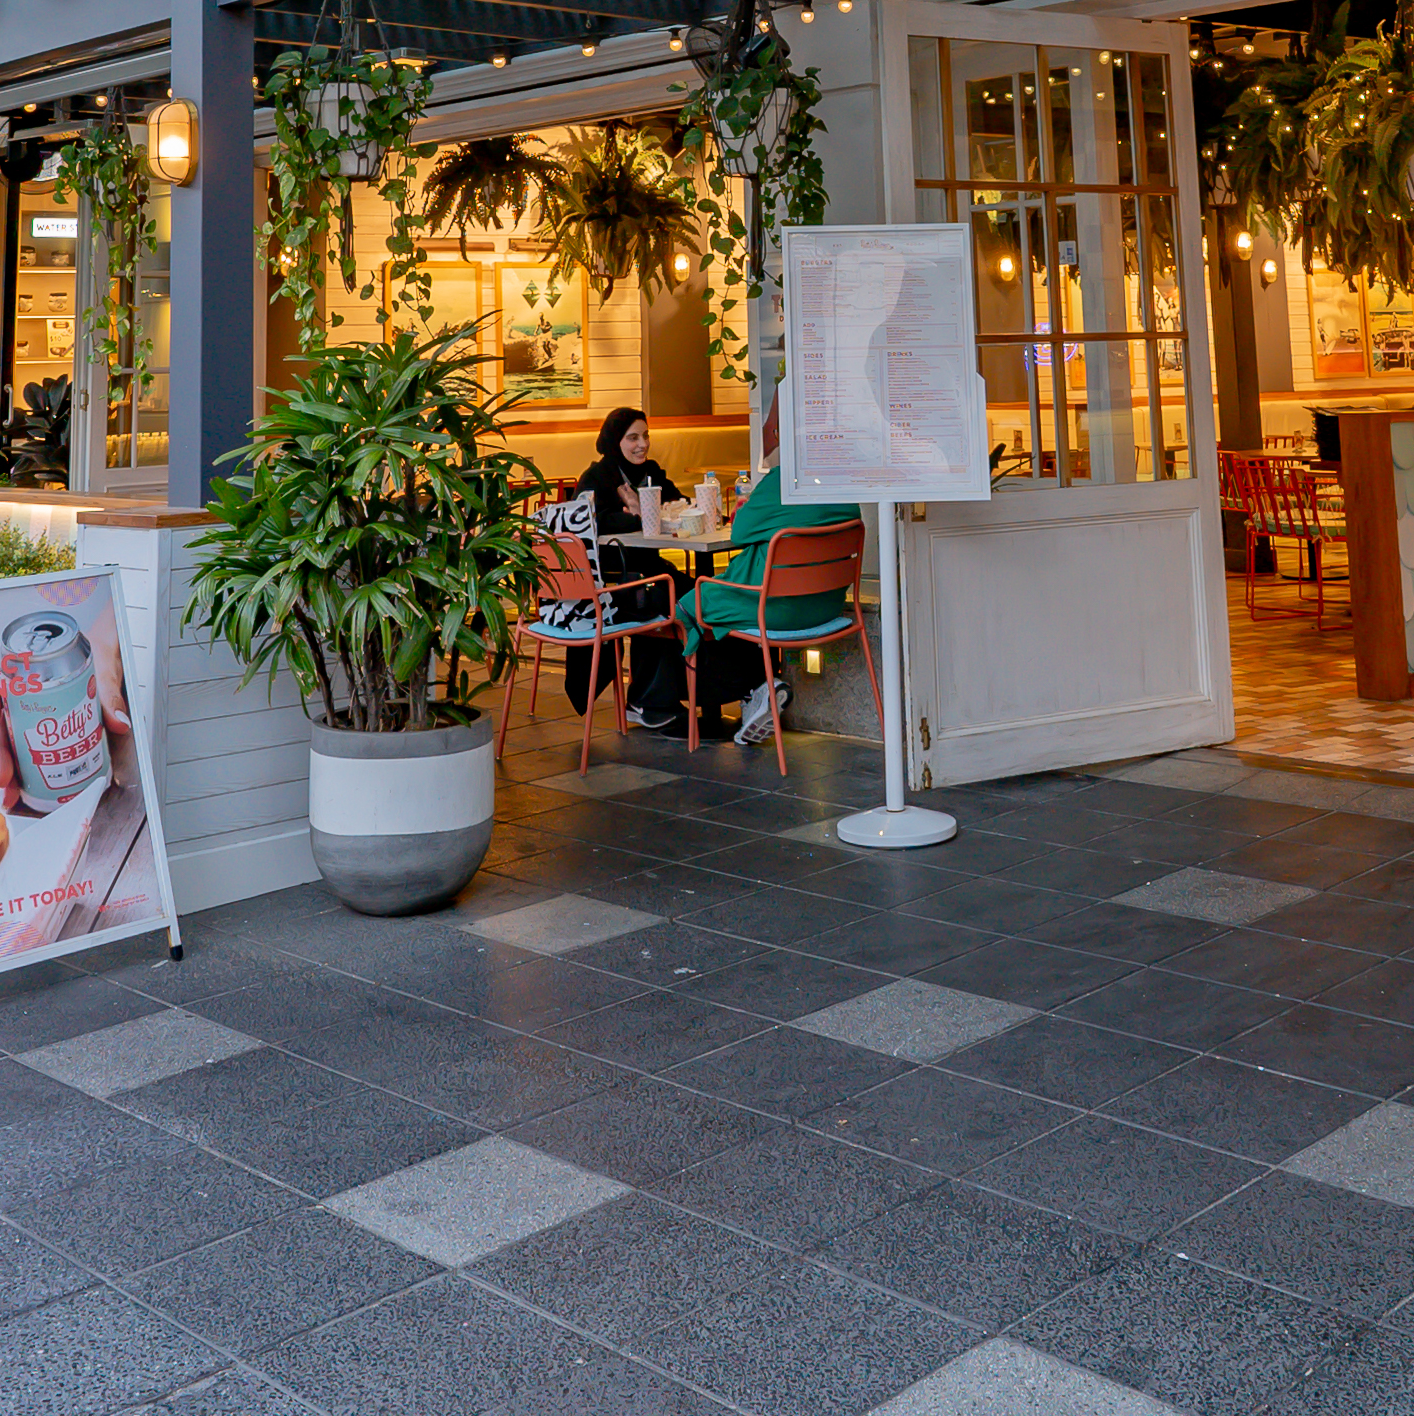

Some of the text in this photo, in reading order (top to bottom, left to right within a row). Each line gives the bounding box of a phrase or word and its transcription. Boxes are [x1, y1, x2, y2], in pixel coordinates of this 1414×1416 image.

[36, 223, 67, 231] WATER
[36, 702, 93, 748] Betty's
[40, 732, 100, 765] BEER
[9, 897, 25, 915] IT
[29, 880, 94, 908] TODAY!
